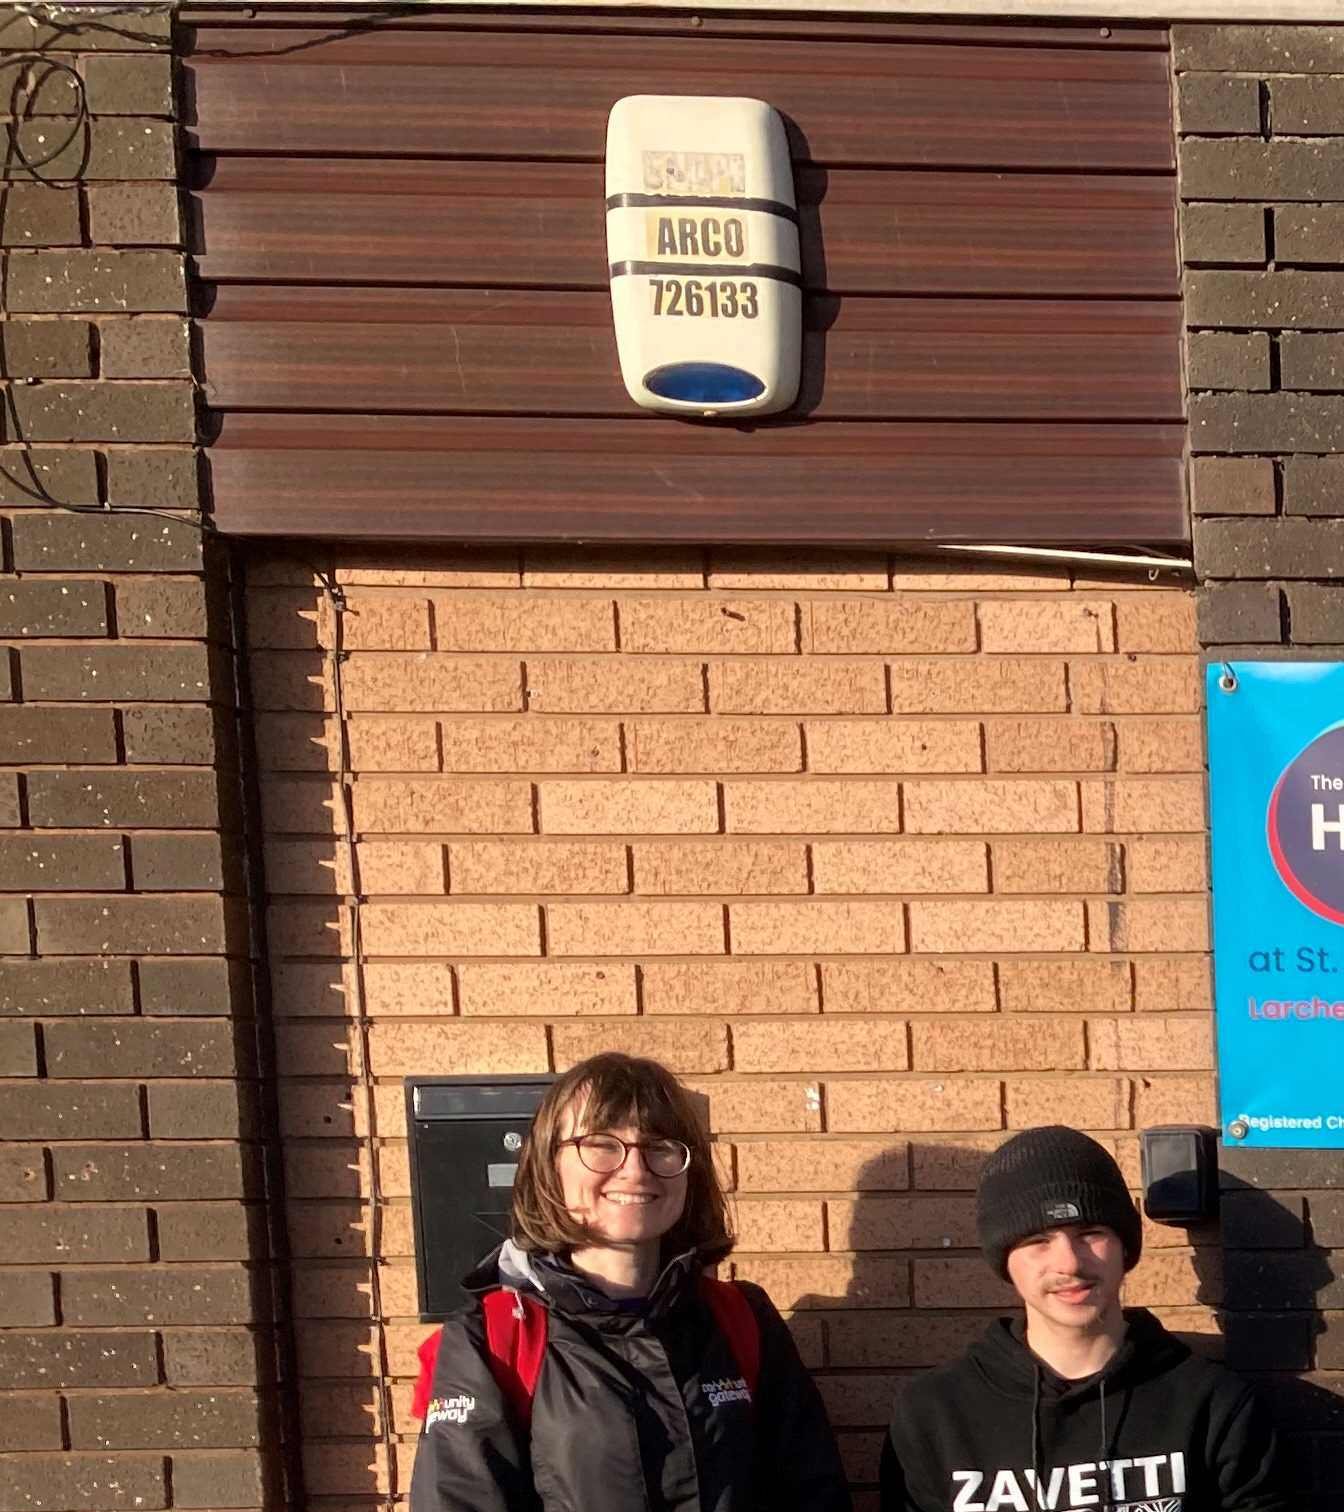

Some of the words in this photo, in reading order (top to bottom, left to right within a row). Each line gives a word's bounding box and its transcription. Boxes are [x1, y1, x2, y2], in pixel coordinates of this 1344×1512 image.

[657, 217, 745, 257] ARCO
[650, 279, 759, 319] 726133
[1311, 774, 1343, 791] The
[1248, 949, 1284, 974] at
[1296, 947, 1338, 974] St.
